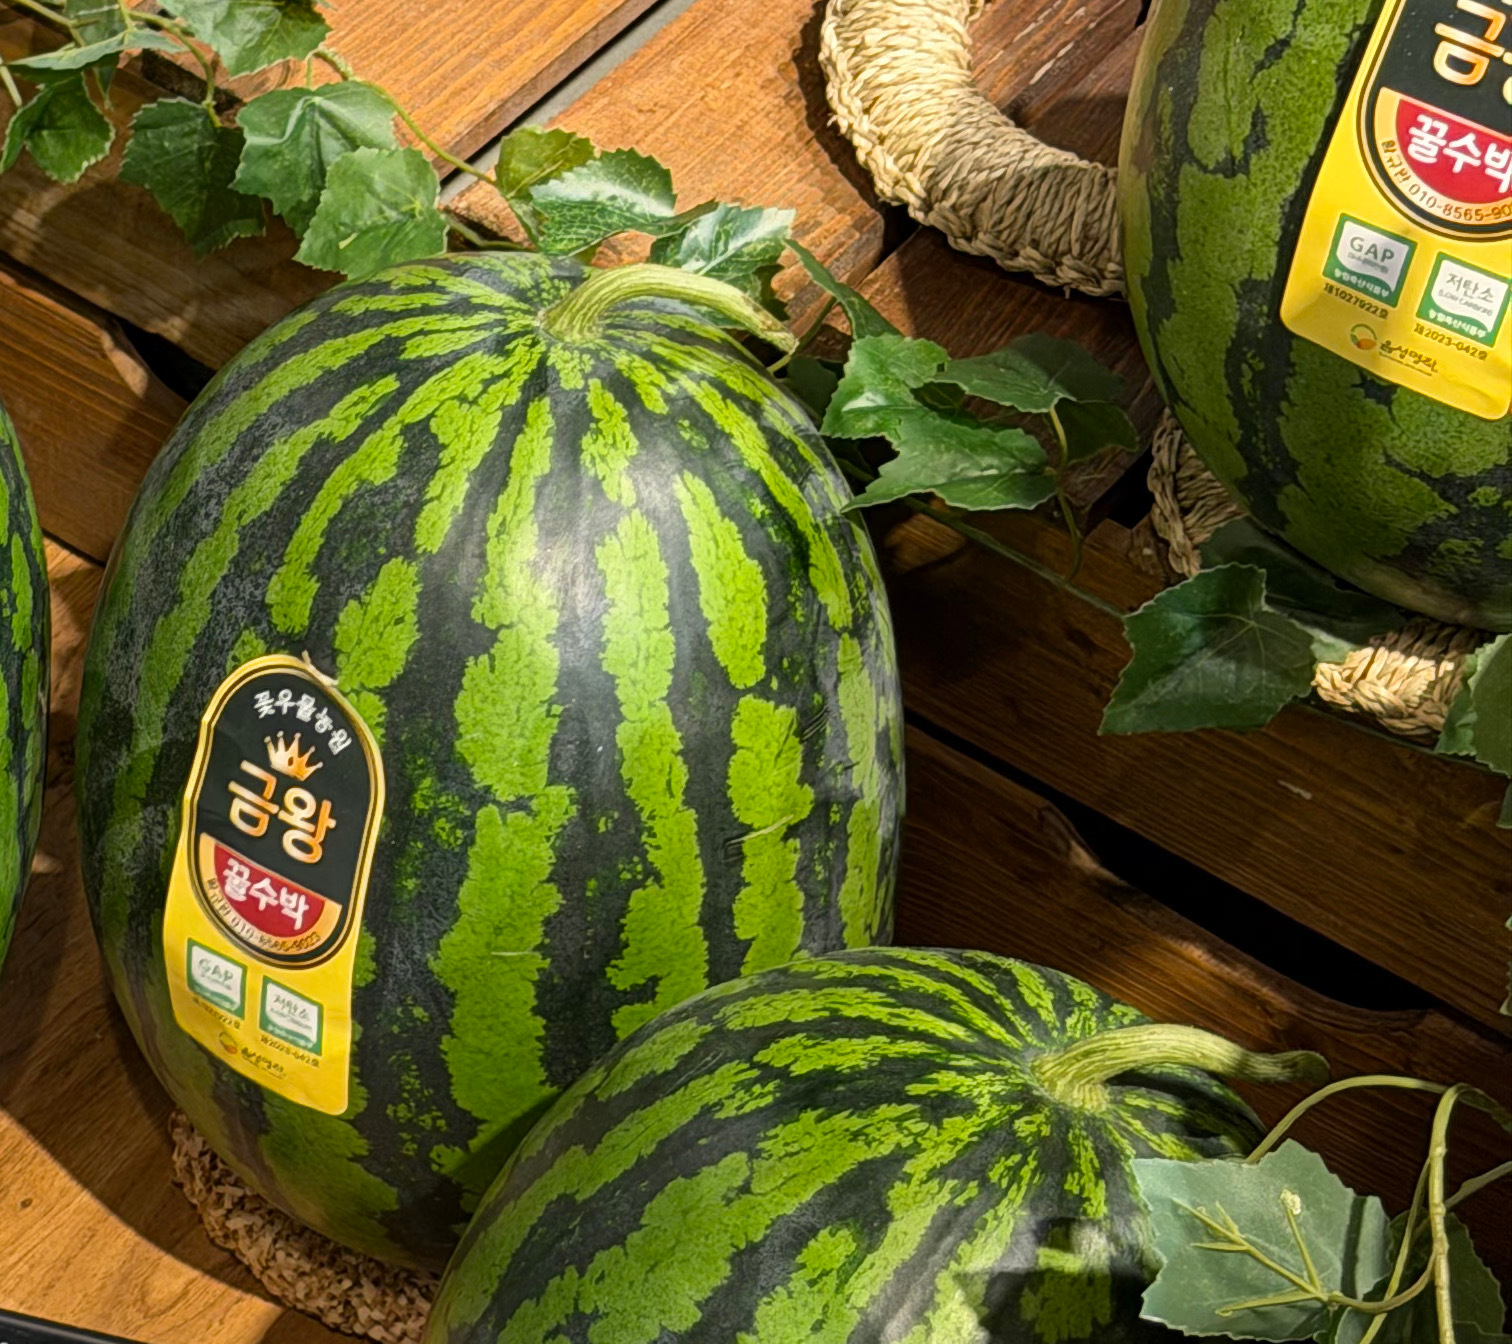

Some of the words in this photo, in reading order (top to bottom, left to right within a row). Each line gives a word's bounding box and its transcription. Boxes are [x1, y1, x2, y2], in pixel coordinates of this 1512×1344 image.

[1407, 113, 1512, 194] 꿀수박
[1407, 183, 1512, 222] 010-8565-90
[1349, 236, 1395, 263] GAP
[1447, 272, 1496, 304] 저탄소
[228, 760, 336, 864] 금왕
[222, 858, 310, 931] 꿀수박
[199, 958, 233, 982] GAP
